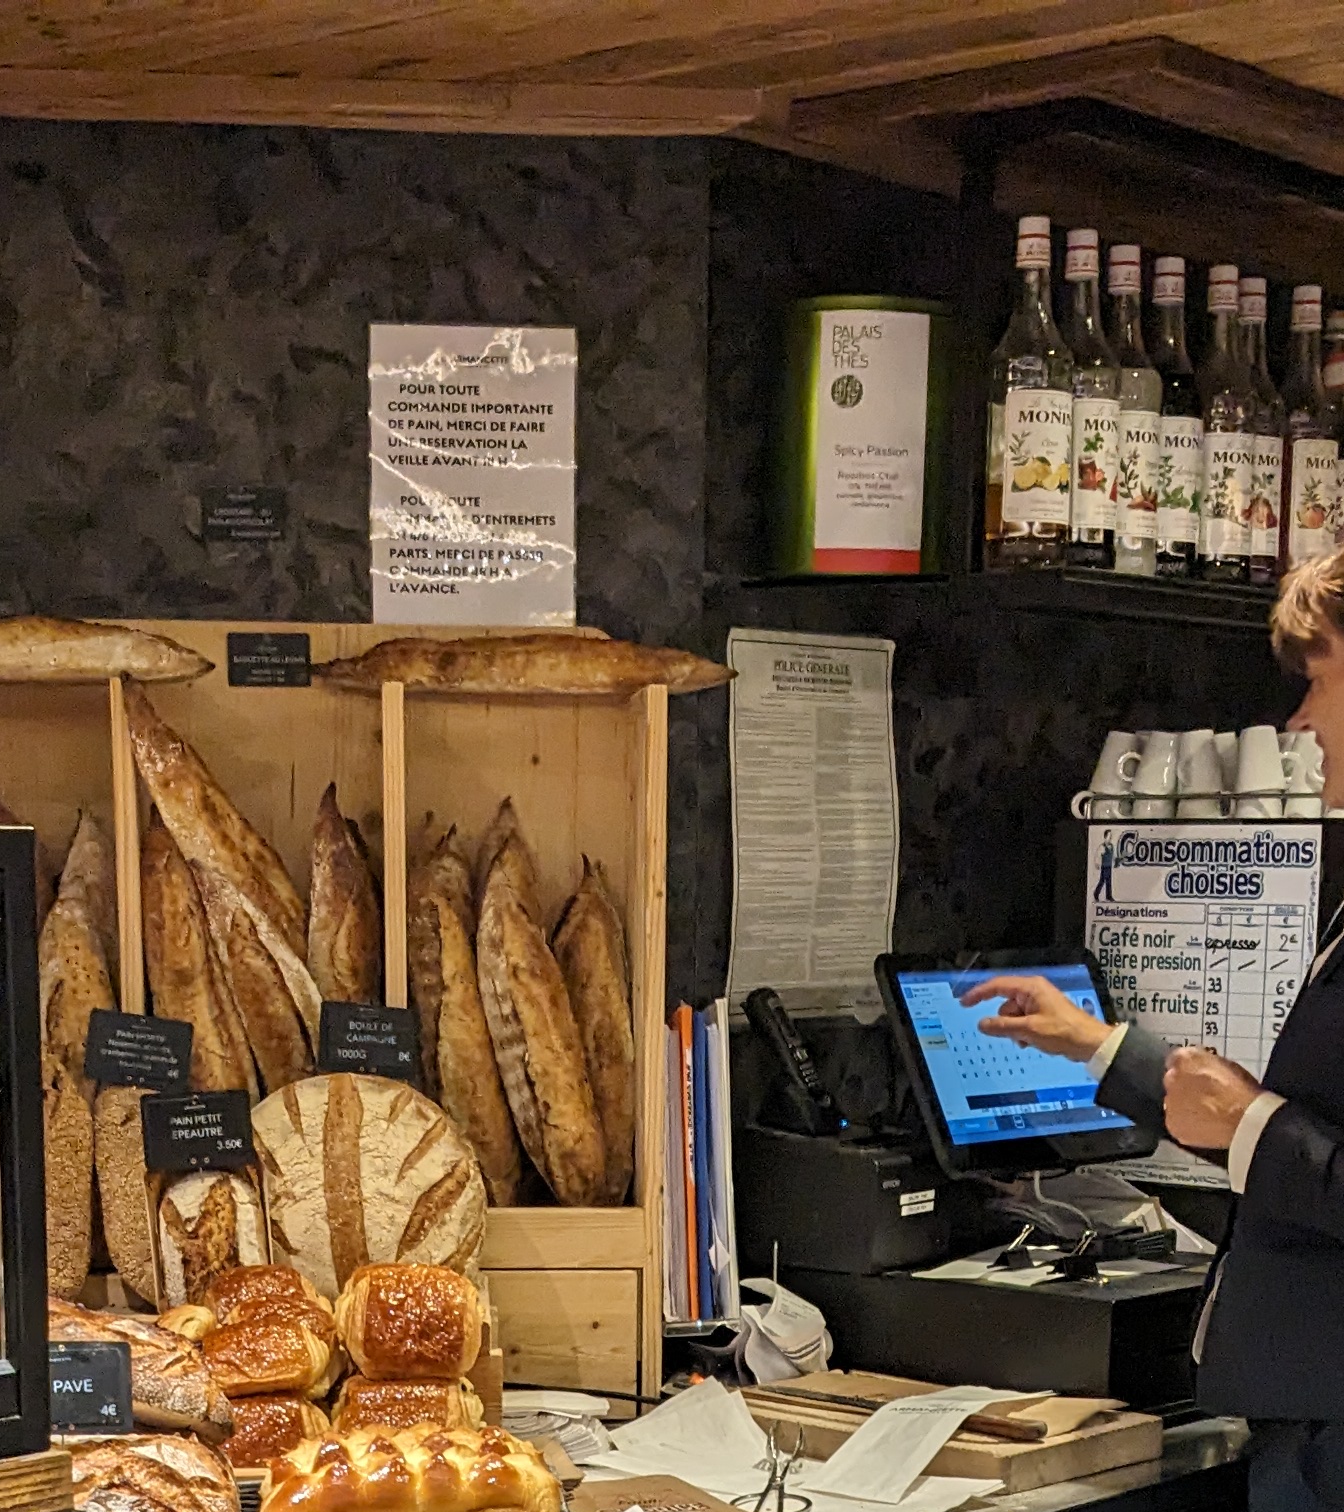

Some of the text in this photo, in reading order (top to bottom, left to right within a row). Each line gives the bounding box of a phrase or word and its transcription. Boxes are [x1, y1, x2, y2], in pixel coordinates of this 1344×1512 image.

[832, 325, 882, 339] PALAIS
[832, 340, 860, 354] DES
[399, 384, 480, 395] POUR TOUTE
[388, 402, 553, 415] COMMANDE IMPORTANTE
[388, 420, 545, 432] DE PAIN, MERCI DE FAIRE
[420, 437, 507, 449] RESERVATION
[511, 439, 528, 449] LA
[867, 445, 908, 457] Passion
[388, 455, 478, 466] VEILLE AVANT
[471, 515, 556, 526] D'ENTREMETS
[435, 549, 475, 559] MERCI
[478, 550, 494, 560] DE
[389, 584, 460, 594] L'AVANCE.
[1118, 831, 1316, 866] Consommations
[1166, 865, 1263, 897] choisies
[1096, 906, 1168, 918] Désignations
[1098, 926, 1175, 948] Café noir
[1098, 950, 1202, 972] Bière pression
[1208, 978, 1222, 992] 33
[1128, 995, 1146, 1012] de
[1150, 993, 1199, 1015] fruits
[1206, 1002, 1220, 1014] 25
[1205, 1022, 1219, 1035] 33
[170, 1114, 222, 1125] PAIN PETIT
[172, 1127, 224, 1140] EPEAUTRE
[53, 1378, 94, 1393] PAVE
[100, 1404, 117, 1416] 4€
